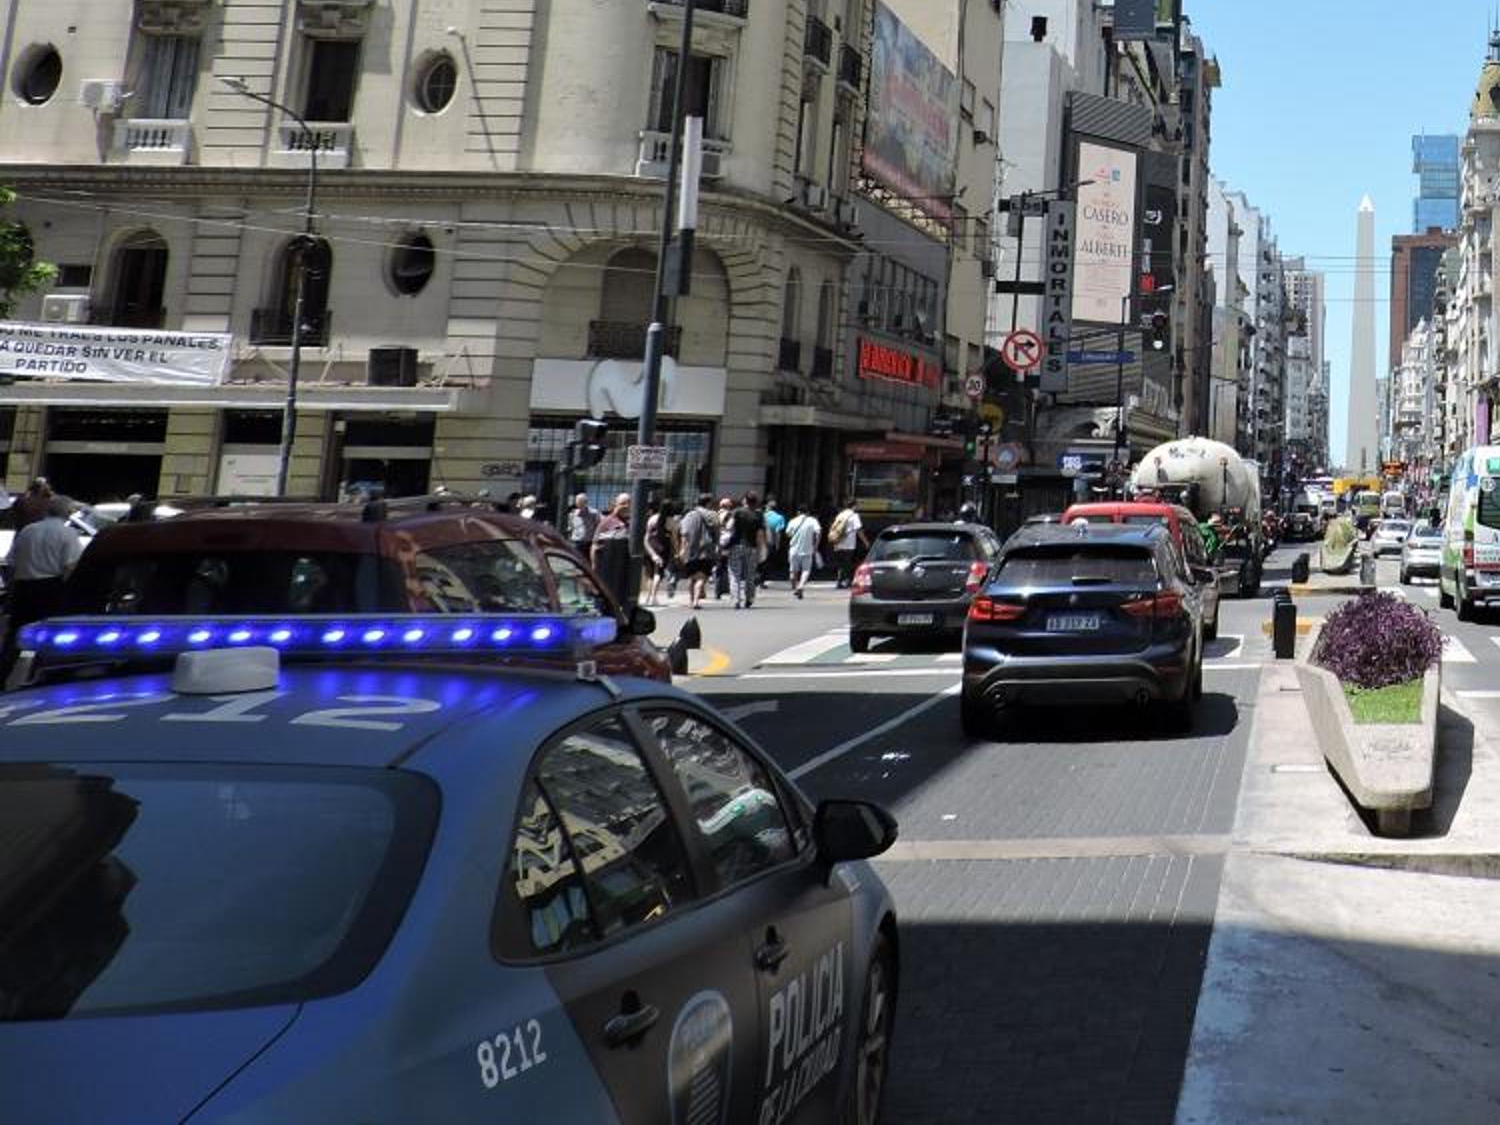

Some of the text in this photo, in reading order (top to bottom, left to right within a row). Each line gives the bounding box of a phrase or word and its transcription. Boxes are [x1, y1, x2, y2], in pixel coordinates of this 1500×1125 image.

[1083, 204, 1129, 225] CASERO
[1050, 213, 1069, 372] INMORTALES
[14, 342, 77, 357] QUEDAR
[81, 346, 110, 358] SIN
[114, 348, 144, 362] VER
[149, 351, 168, 364] EL
[15, 358, 88, 374] PARTIDO
[767, 940, 843, 1088] POLICIA
[477, 1017, 547, 1089] 8212
